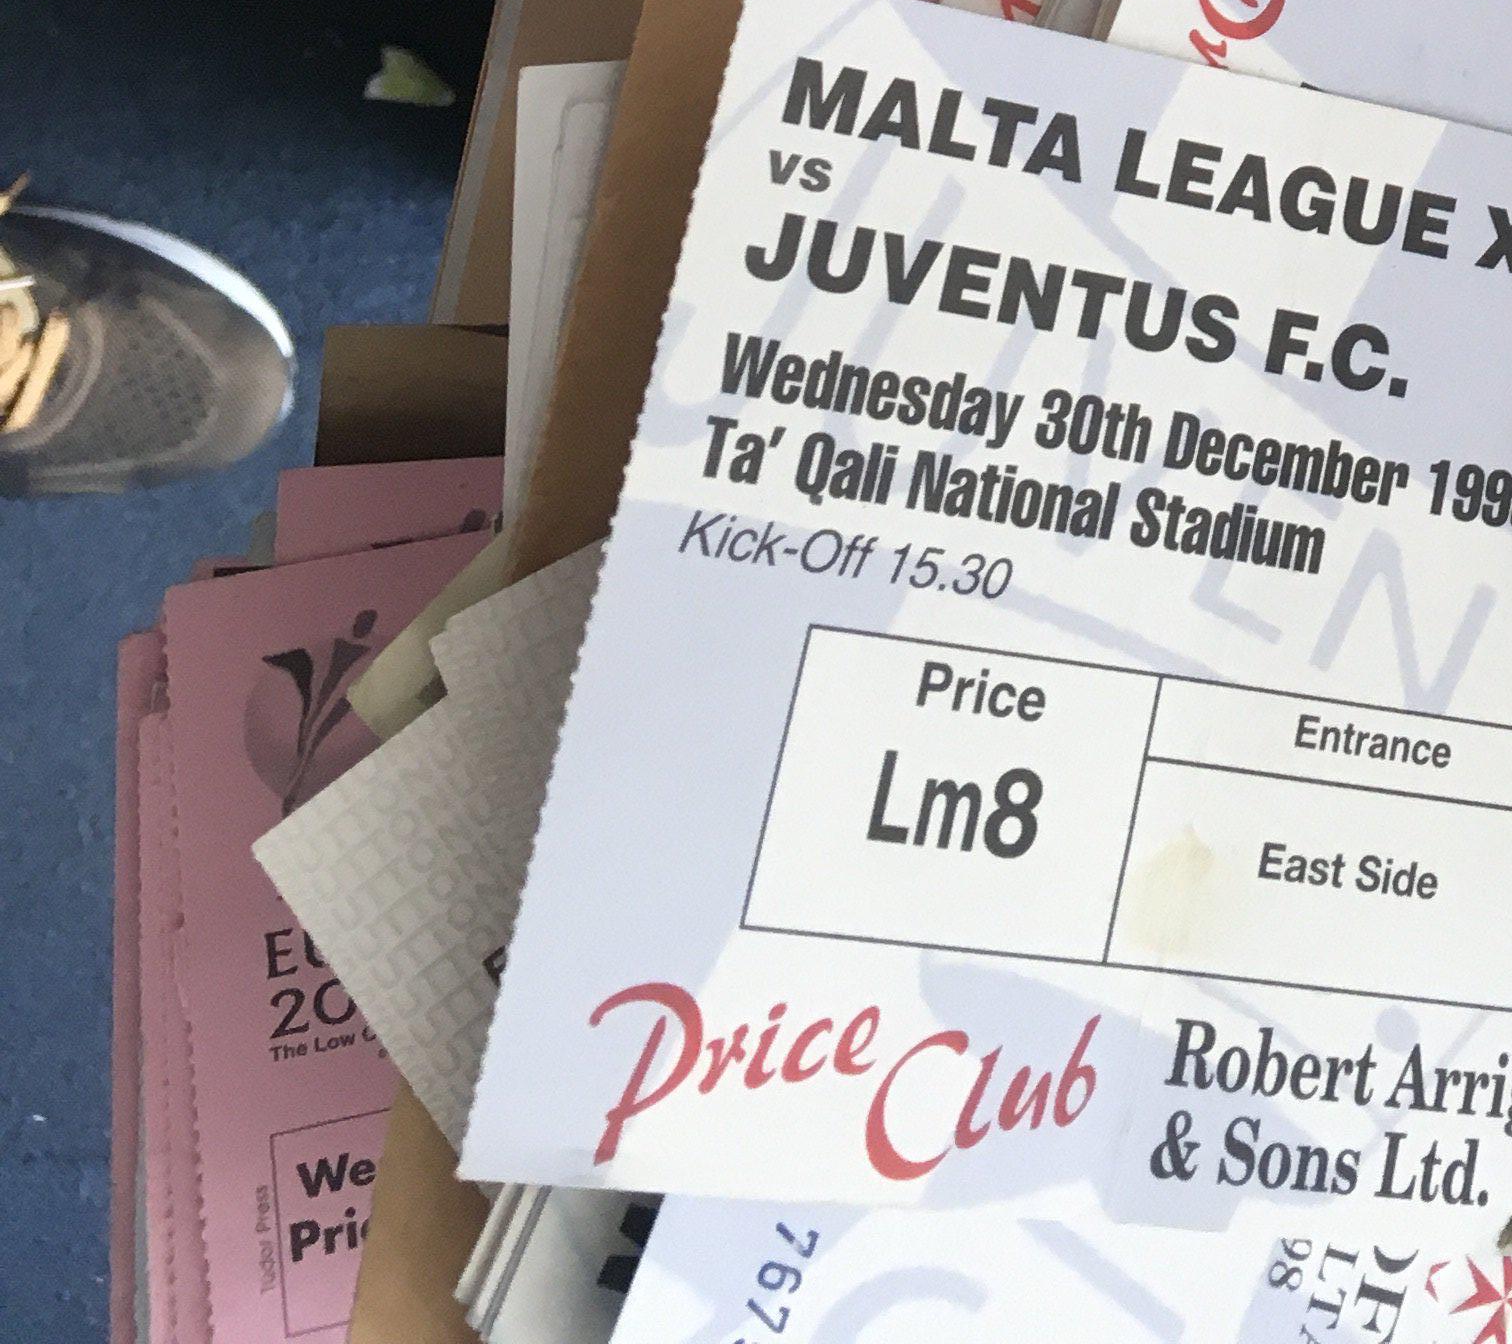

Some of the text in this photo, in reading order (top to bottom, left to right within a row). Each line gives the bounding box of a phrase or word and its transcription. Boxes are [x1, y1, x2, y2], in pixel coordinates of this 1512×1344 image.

[768, 149, 833, 194] vs
[778, 57, 1087, 186] MALTA
[1113, 126, 1457, 259] LEAGUE
[742, 212, 1412, 400] JUVENTUS F.C.
[717, 332, 1024, 447] Wednesday
[1032, 382, 1155, 469] 30th
[1164, 413, 1410, 511] December
[796, 430, 899, 508] Qali
[905, 443, 1122, 545] National
[1128, 484, 1329, 577] Stadium
[673, 509, 1016, 603] Kick-Off 15.30
[913, 658, 1050, 726] Price
[1291, 714, 1457, 775] Entrance
[864, 747, 1048, 863] Lm8
[1254, 841, 1443, 904] East Side
[586, 978, 1100, 1182] Price Club
[1163, 1014, 1382, 1112] Robert
[1147, 1110, 1495, 1211] & Sons Ltd.
